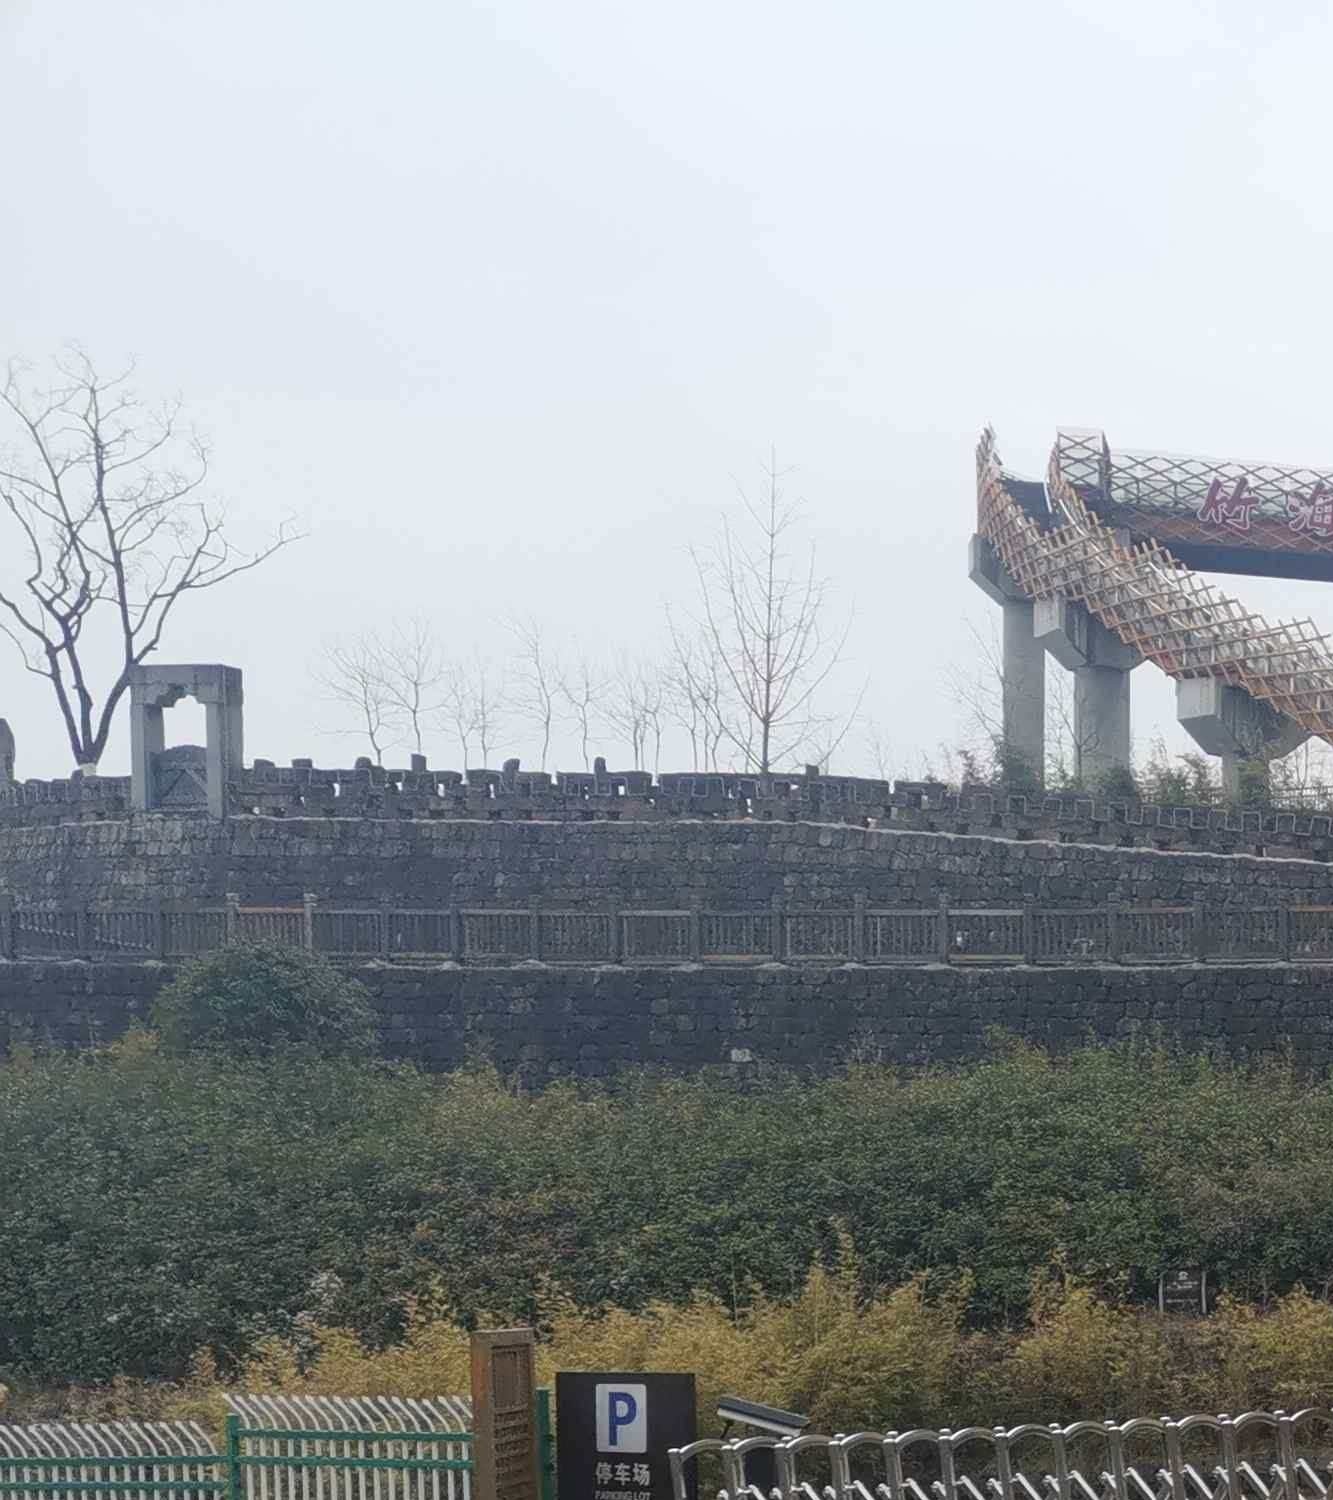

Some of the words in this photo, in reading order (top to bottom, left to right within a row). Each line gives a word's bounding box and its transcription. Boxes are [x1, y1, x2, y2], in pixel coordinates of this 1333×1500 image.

[608, 1391, 637, 1447] P
[595, 1462, 650, 1486] 停车场
